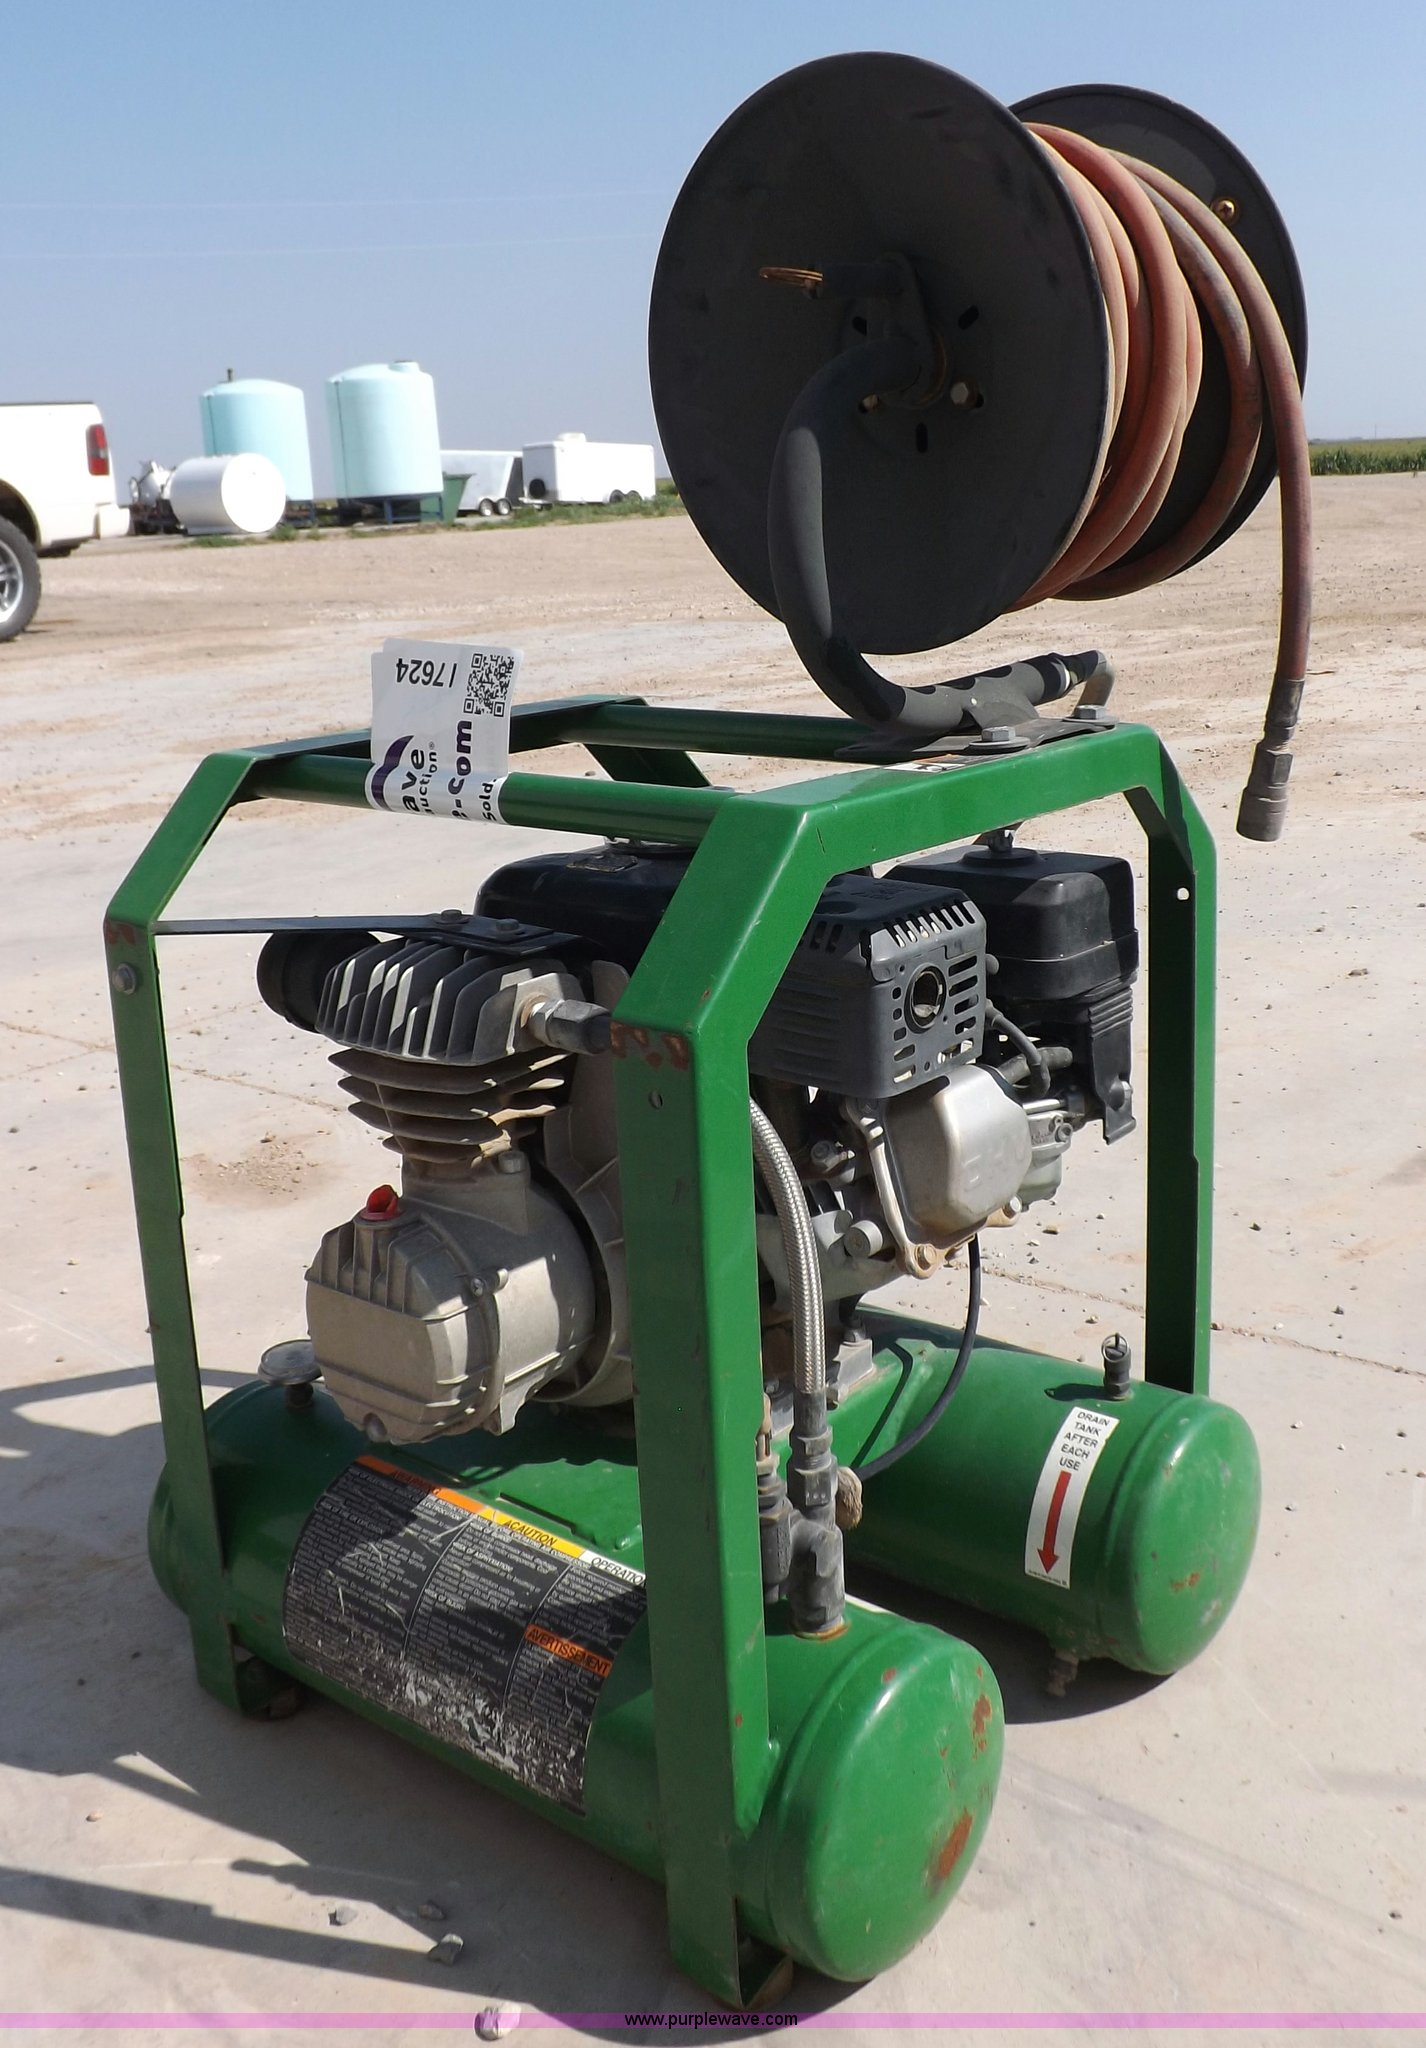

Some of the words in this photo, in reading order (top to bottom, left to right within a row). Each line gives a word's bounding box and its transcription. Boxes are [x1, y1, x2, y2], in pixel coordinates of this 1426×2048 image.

[396, 658, 457, 688] 17624
[1077, 1411, 1110, 1426] DRAIN
[1075, 1421, 1101, 1436] TANK
[1064, 1432, 1099, 1448] AFTER
[1061, 1443, 1090, 1459] EACH
[1059, 1456, 1081, 1471] USE
[591, 1556, 643, 1584] OPERATIO
[527, 1627, 611, 1674] AVERTISSEMENT
